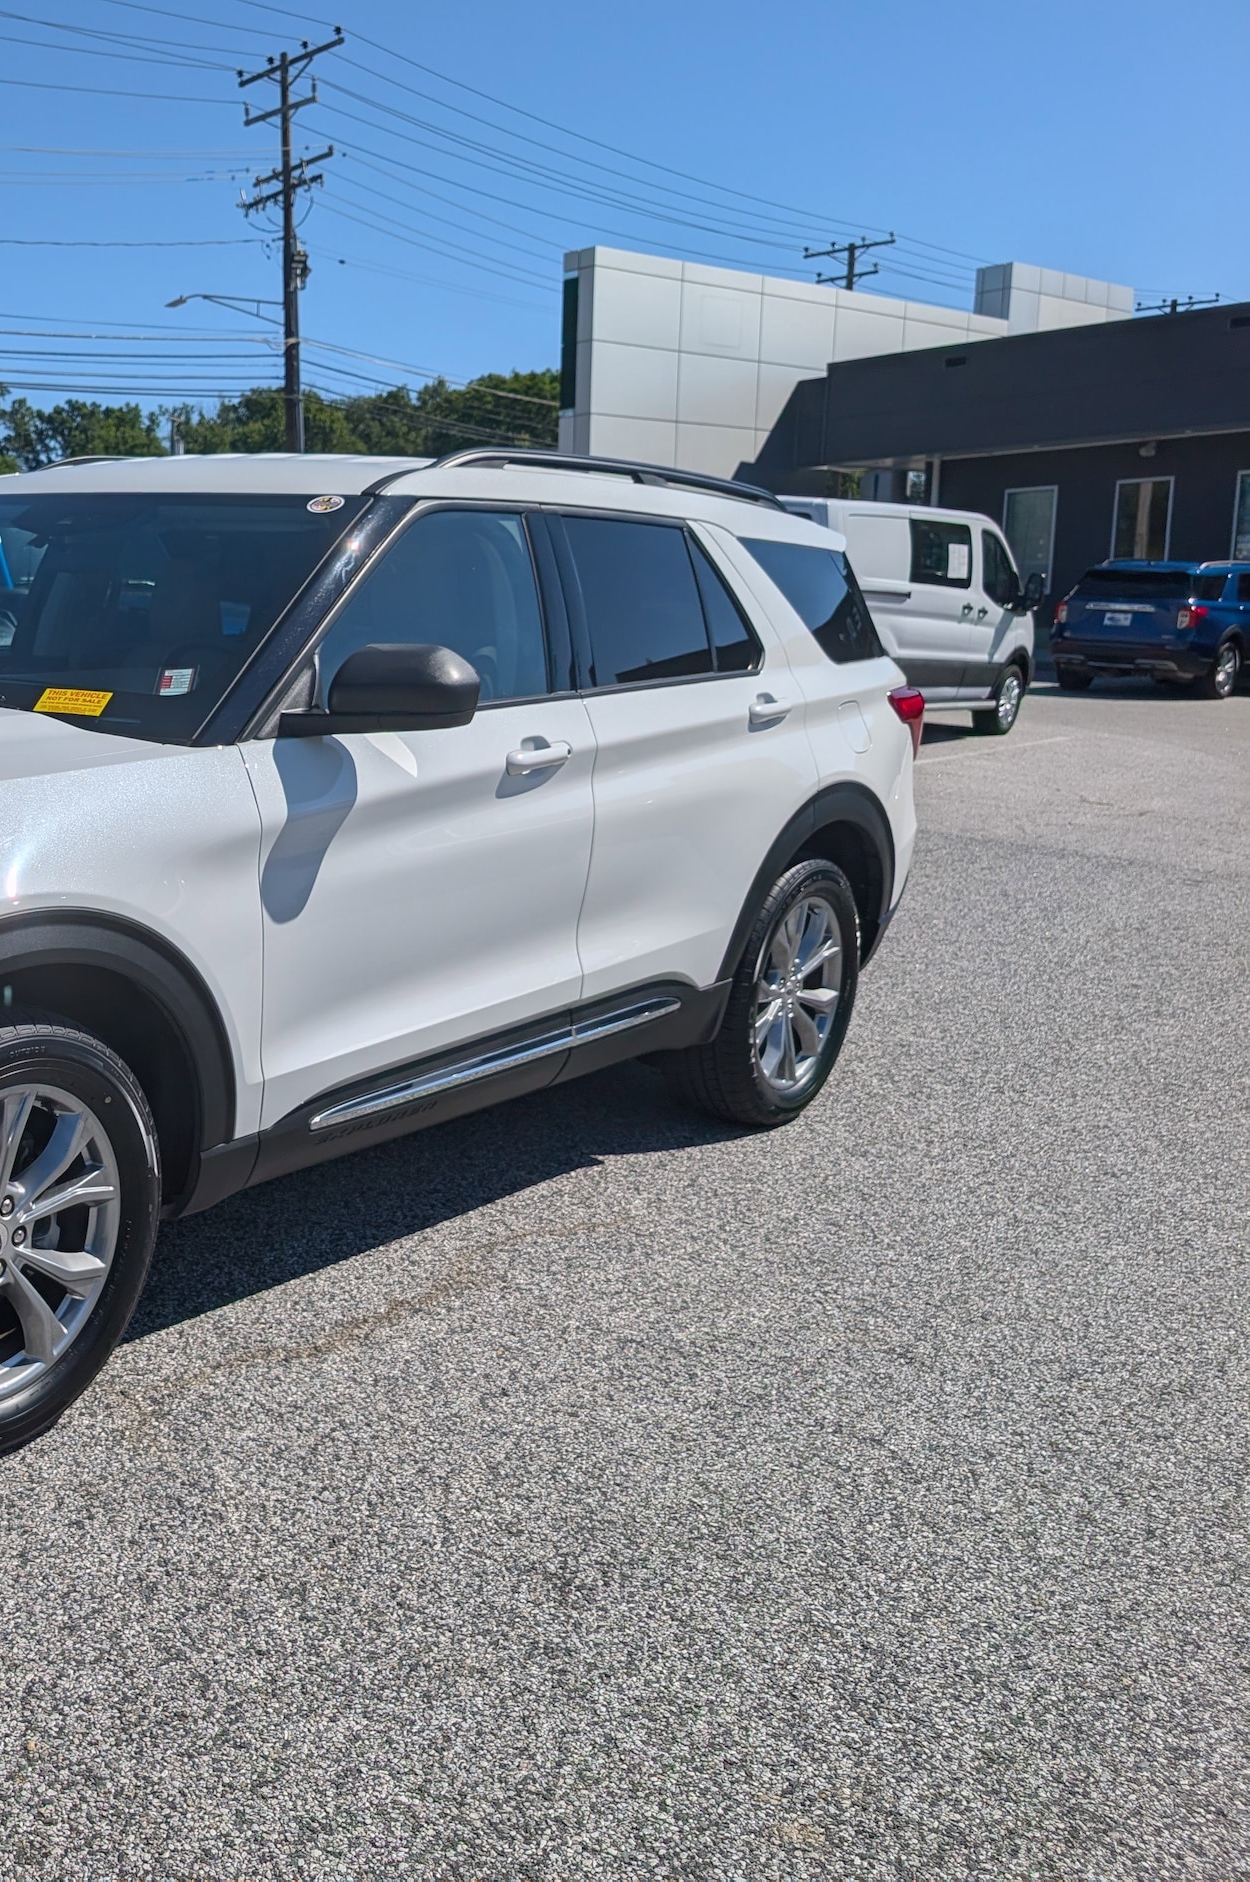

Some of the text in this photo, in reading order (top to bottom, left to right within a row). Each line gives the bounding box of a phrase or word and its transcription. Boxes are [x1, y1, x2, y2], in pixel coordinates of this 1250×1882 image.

[48, 689, 108, 700] THIS VEHICLE
[81, 697, 104, 705] SALE
